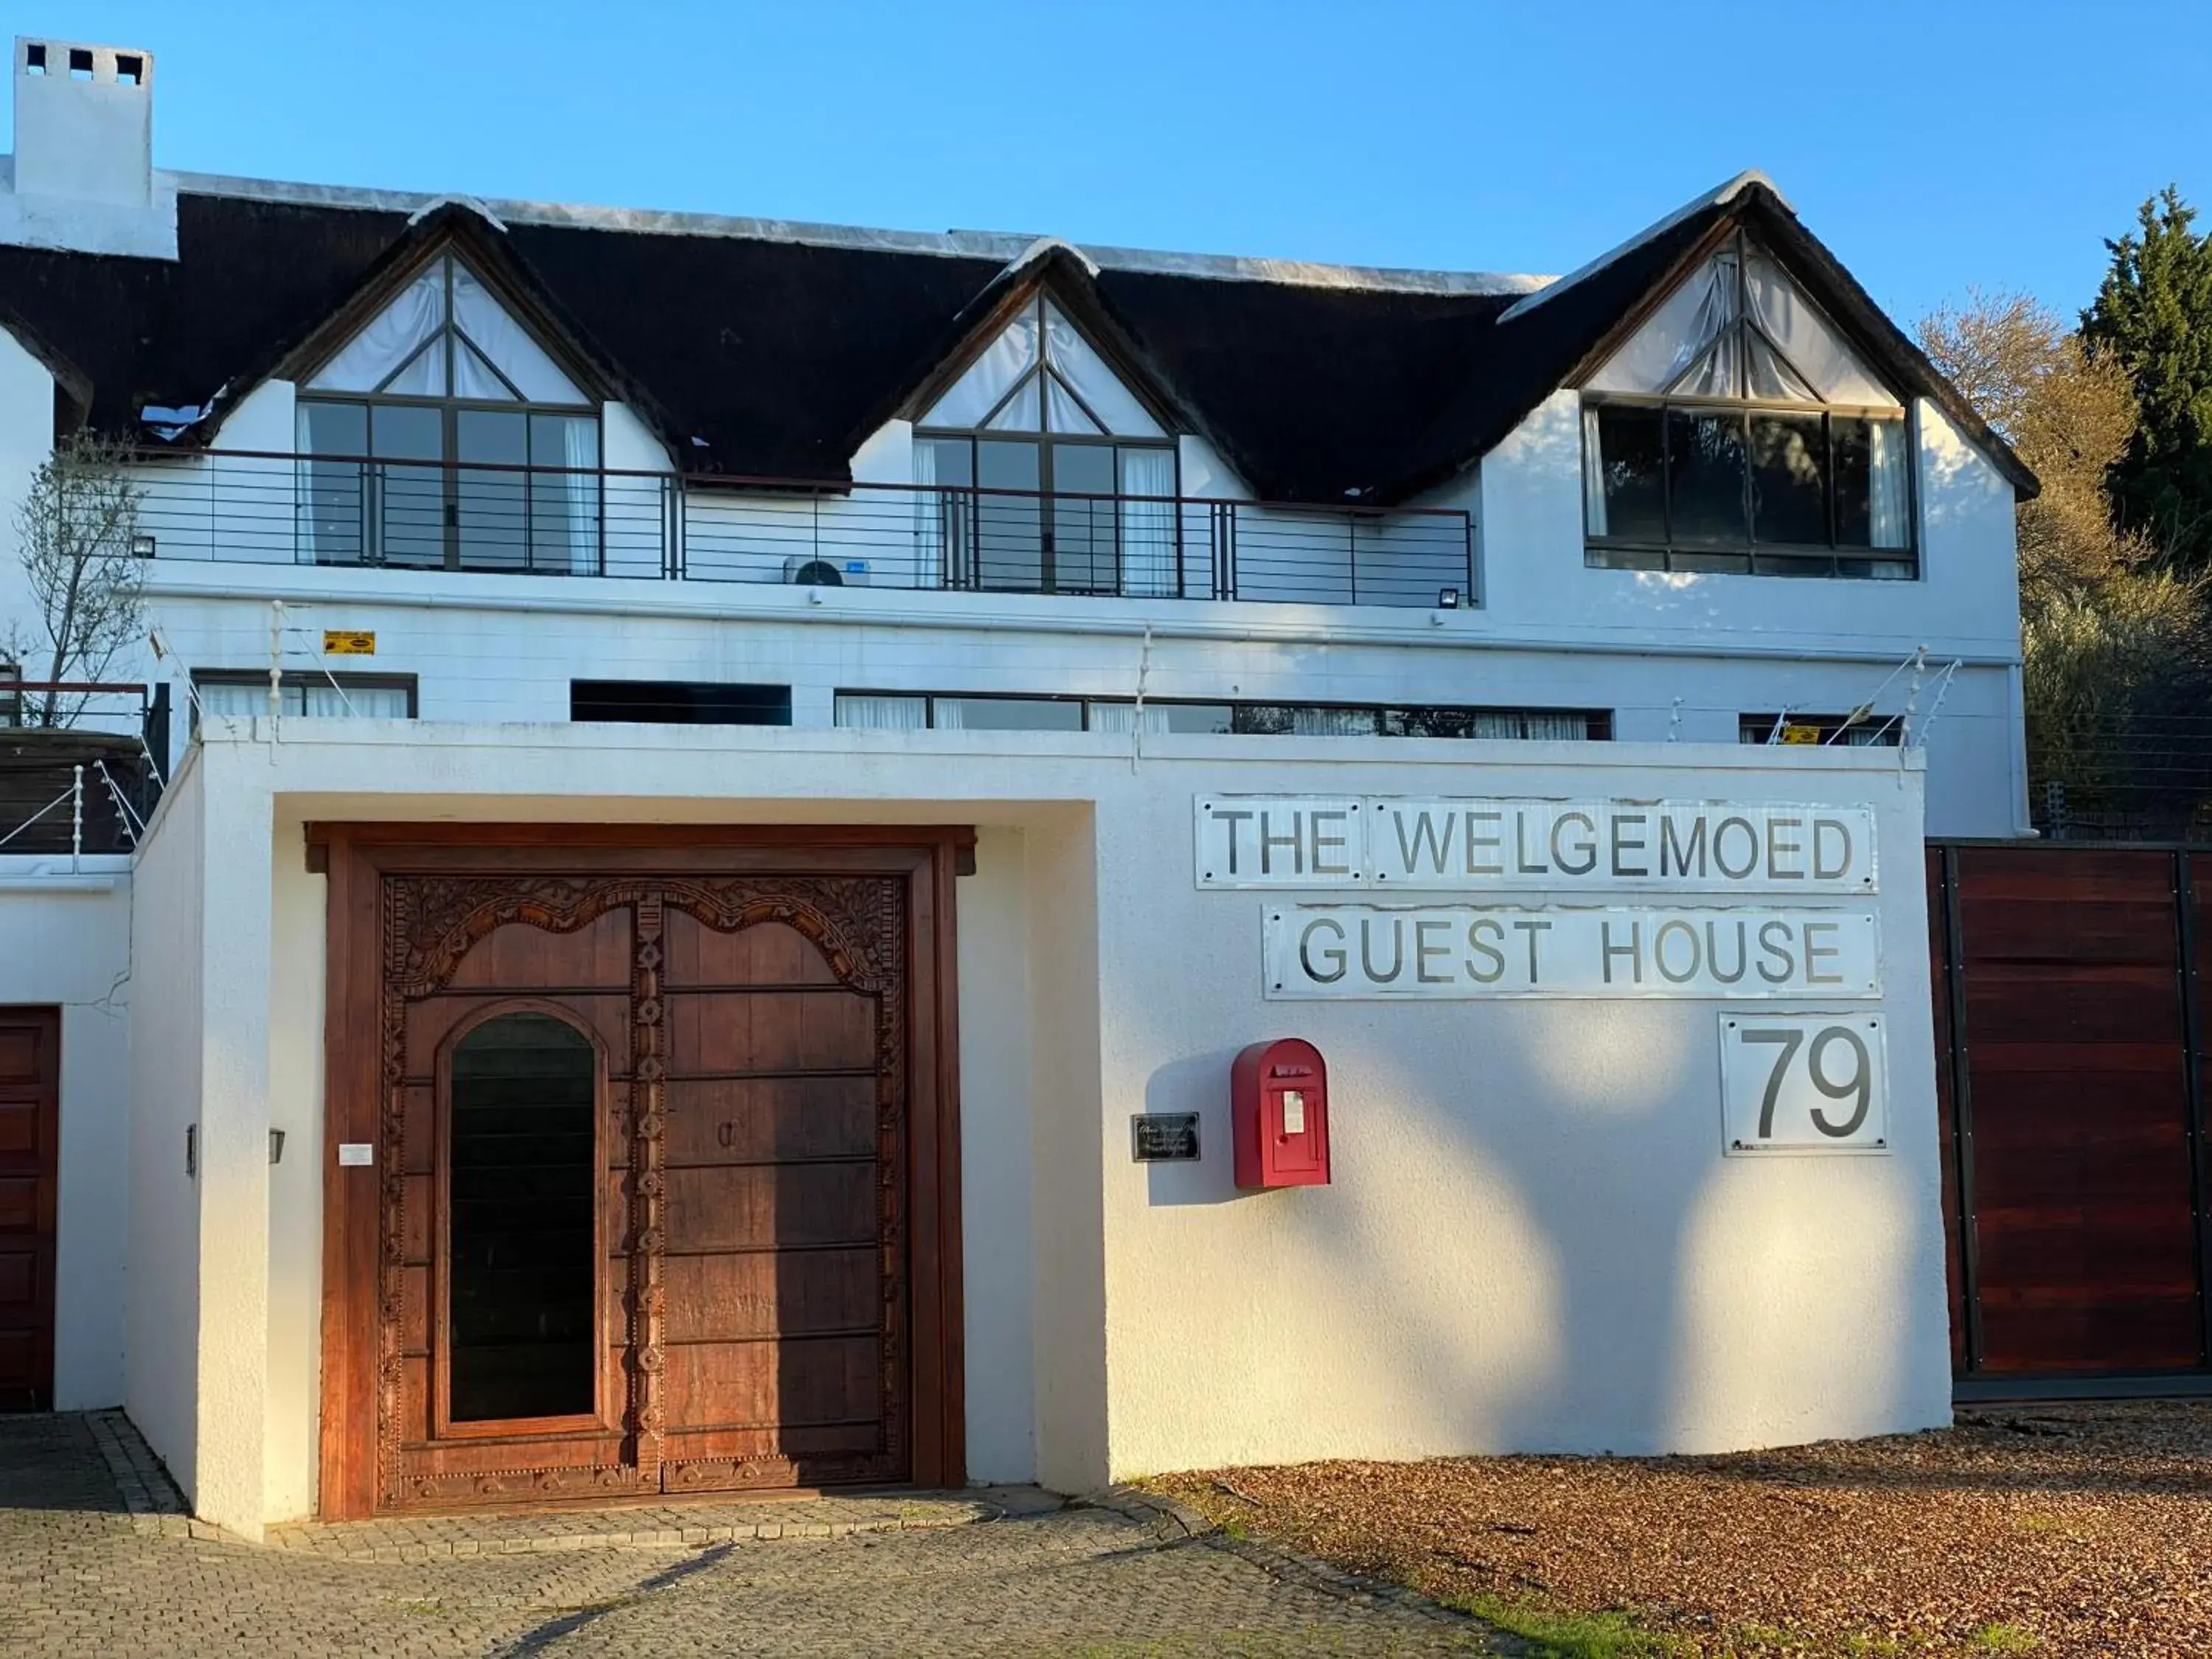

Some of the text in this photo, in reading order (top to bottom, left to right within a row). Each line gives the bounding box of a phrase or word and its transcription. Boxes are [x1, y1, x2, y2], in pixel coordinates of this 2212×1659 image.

[1211, 810, 1853, 880] THE WELGEMOED
[1298, 918, 1846, 985] GUEST HOUSE
[1741, 1026, 1871, 1138] 79
